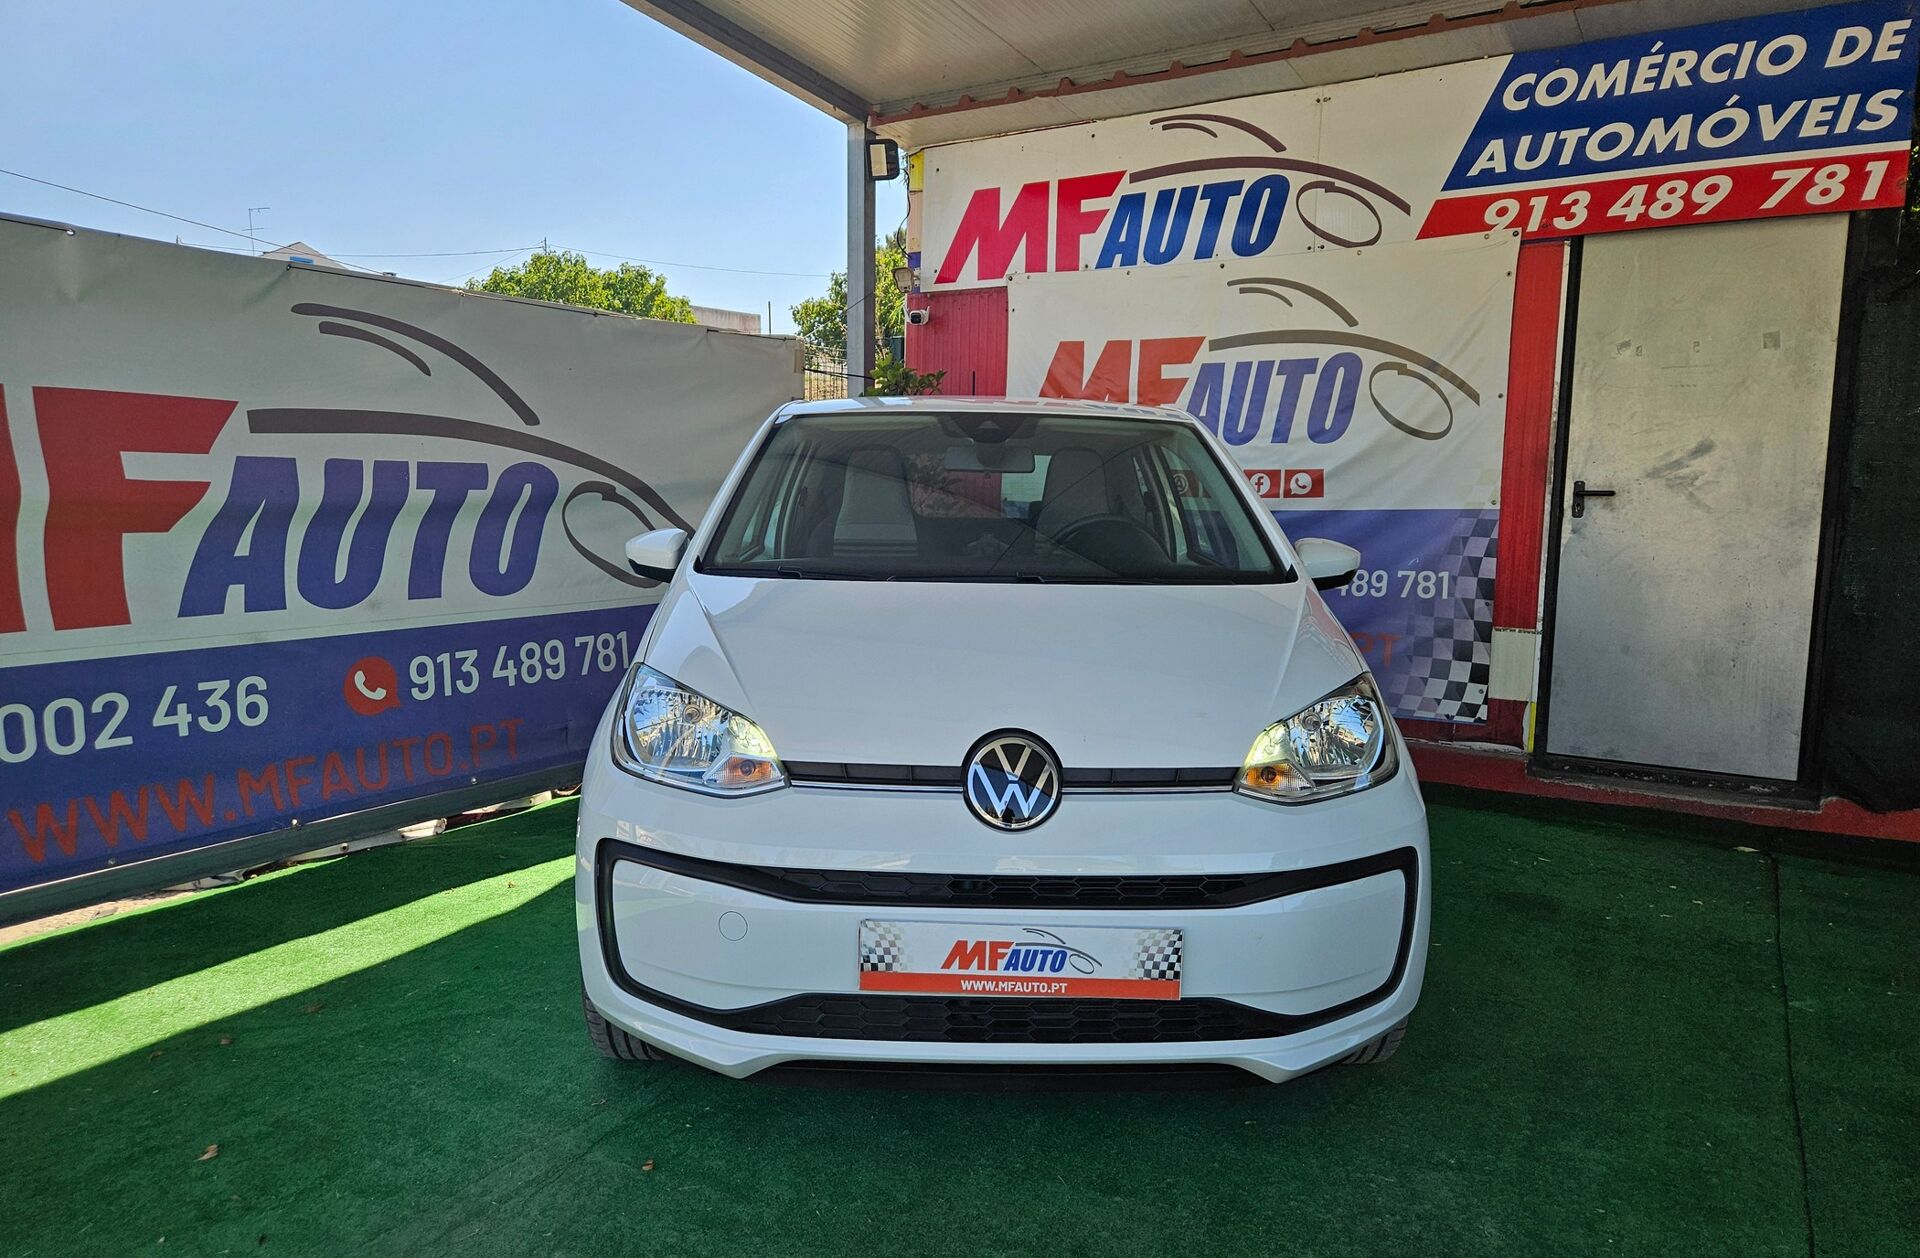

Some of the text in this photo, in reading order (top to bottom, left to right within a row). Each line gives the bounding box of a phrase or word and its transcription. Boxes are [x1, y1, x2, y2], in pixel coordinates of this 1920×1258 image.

[1502, 19, 1912, 111] COMÉRCIO DE
[1467, 89, 1904, 177] AUTOMÓVEIS
[1484, 160, 1890, 232] 913 489 781
[1398, 570, 1449, 600] 781
[409, 630, 629, 701] 913 489 781
[0, 675, 268, 763] 002 436
[7, 717, 524, 863] WWW.MFAUTO.PT
[961, 979, 1068, 994] WWW.MFAUTO.PT
